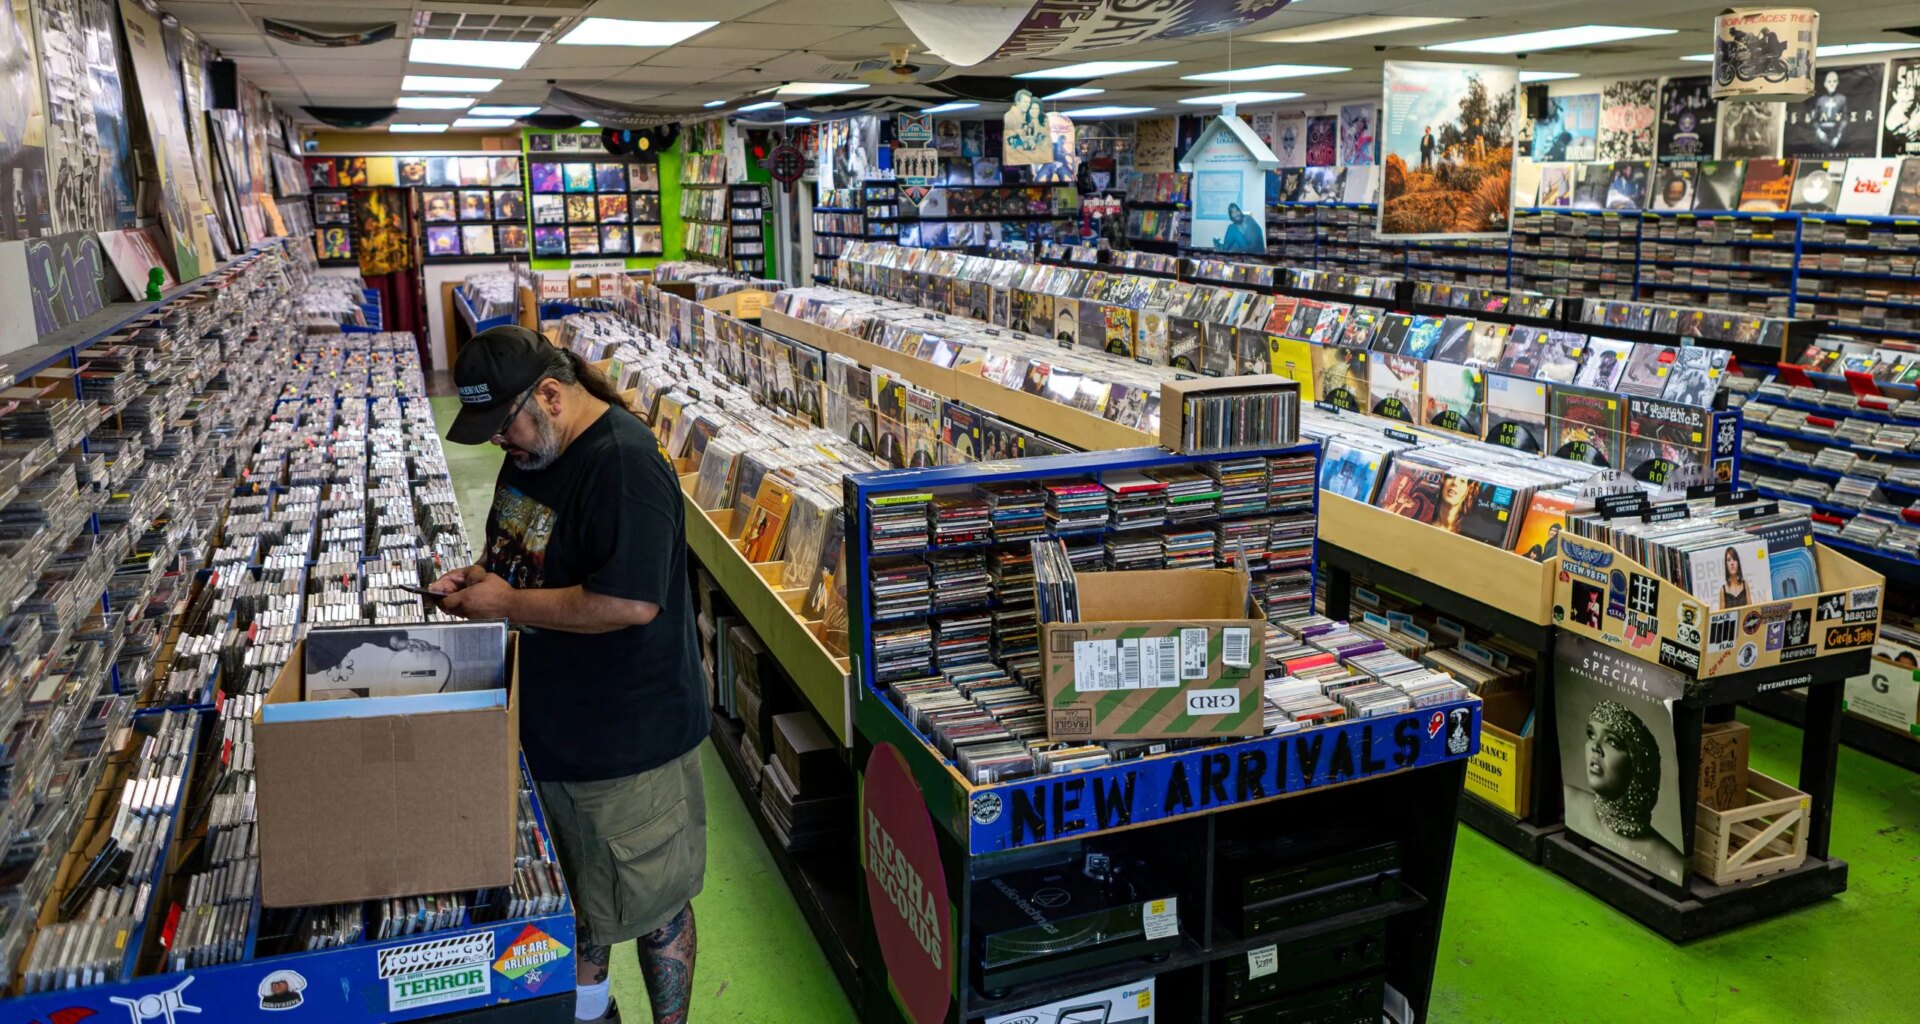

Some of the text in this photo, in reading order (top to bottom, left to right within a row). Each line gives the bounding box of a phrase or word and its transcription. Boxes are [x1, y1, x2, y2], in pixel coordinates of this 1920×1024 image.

[544, 285, 568, 293] SALE
[1336, 390, 1348, 399] POP
[1333, 398, 1349, 409] ROCK
[1386, 398, 1400, 407] POP
[1383, 406, 1401, 418] ROCK
[1445, 412, 1460, 422] POP
[1442, 420, 1461, 431] ROCK
[1502, 423, 1518, 434] POP
[1683, 463, 1704, 475] NEW
[1601, 471, 1622, 481] NEW
[1583, 485, 1638, 498] ARRIVALS
[1616, 504, 1639, 513] COUNTRY
[1651, 511, 1685, 522] NEW REISSUES
[1597, 573, 1608, 583] FM
[1608, 609, 1625, 620] TEXAS
[1711, 613, 1731, 623] BLACK
[1718, 642, 1734, 651] FLAG
[1661, 642, 1700, 664] RELAPSE
[1593, 650, 1643, 675] NEW ALBUM
[1570, 666, 1613, 688] AVAILABLE
[1617, 684, 1637, 696] JULY
[1583, 658, 1649, 692] SPECIAL
[1762, 677, 1807, 691] EYEHATEGOD
[1871, 673, 1890, 694] G
[1190, 693, 1236, 709] GRD
[1054, 720, 1089, 728] FRAGILE
[1009, 719, 1422, 849] NEW ARRIVALS
[868, 808, 942, 942] KESHA
[869, 844, 942, 970] RECORDS
[991, 878, 1059, 934] audio-technica
[512, 940, 549, 957] WE ARE
[390, 949, 445, 967] TOUCH
[463, 943, 485, 955] GO
[503, 953, 558, 971] ARLINGTON
[394, 968, 485, 997] TERROR
[262, 998, 301, 1009] DERIVATIVE
